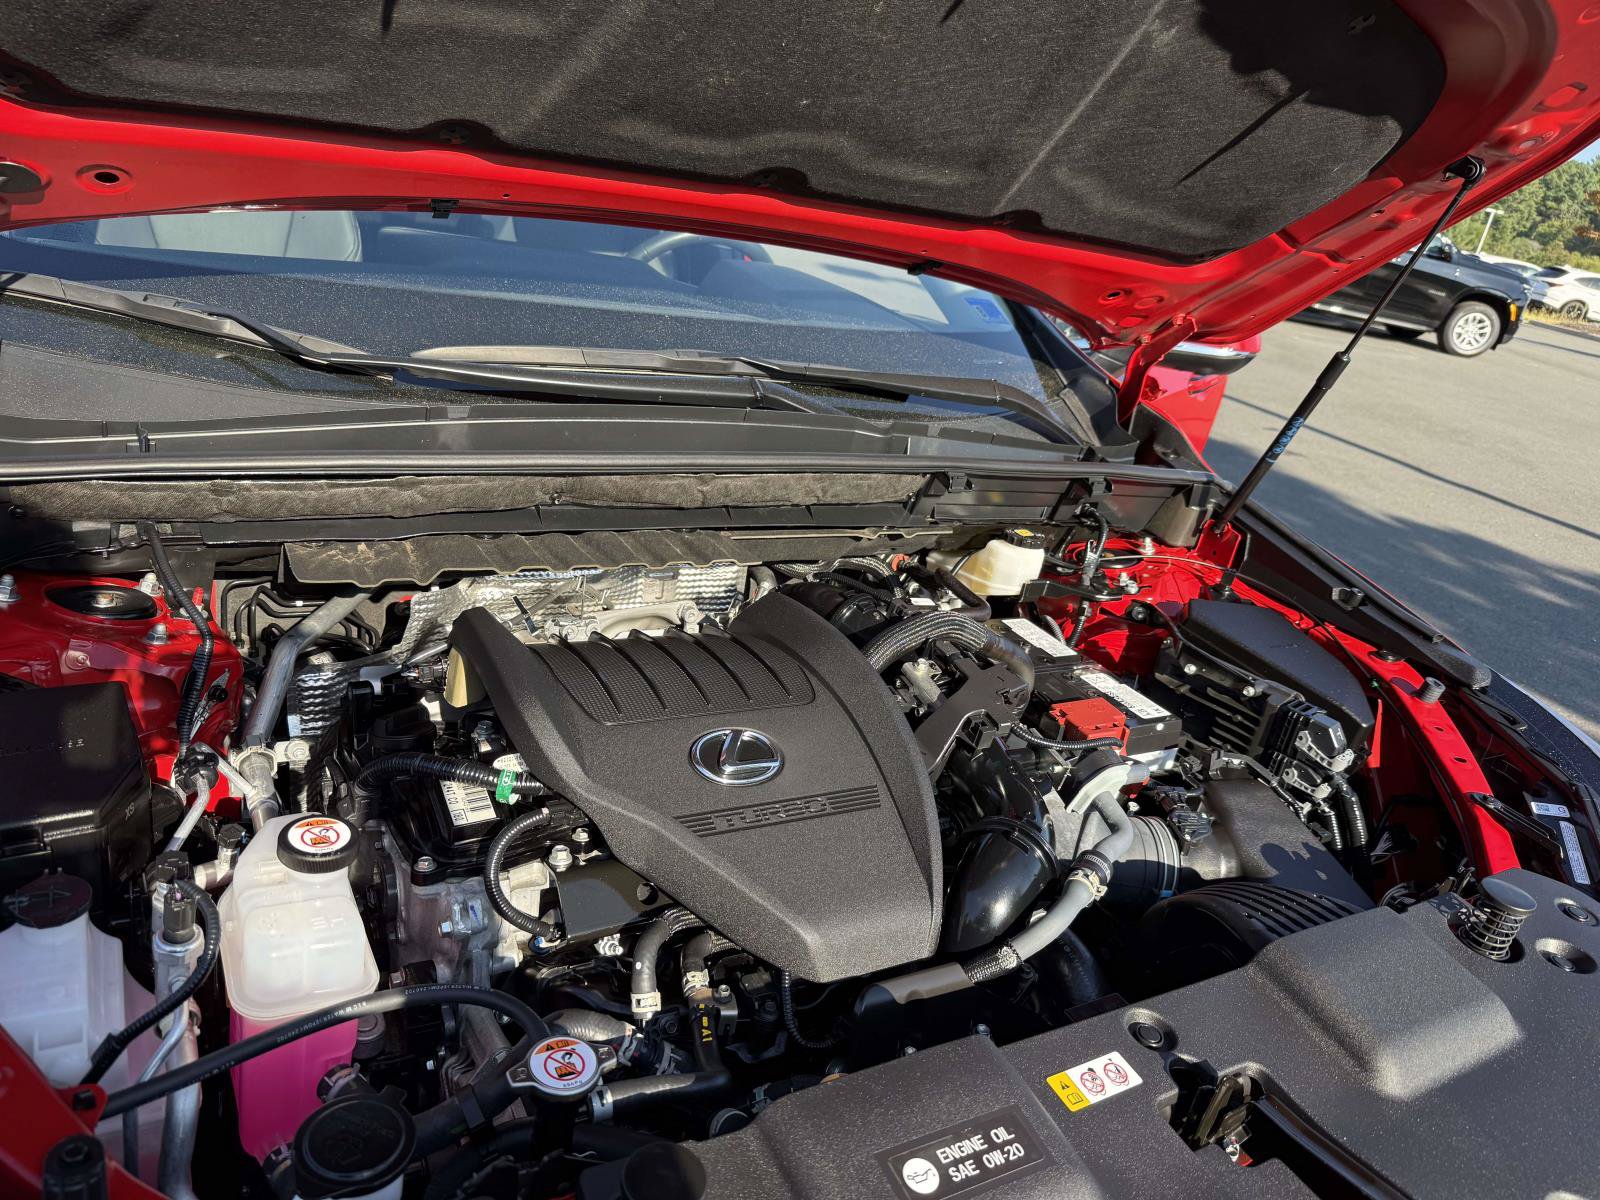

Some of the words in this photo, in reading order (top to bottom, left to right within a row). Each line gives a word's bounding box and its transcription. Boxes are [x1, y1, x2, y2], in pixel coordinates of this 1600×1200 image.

[714, 797, 828, 827] TURBO
[936, 1134, 988, 1164] ENGINE
[990, 1126, 1016, 1143] OIL
[948, 1160, 980, 1182] SAE
[982, 1142, 1025, 1169] 0W-20
